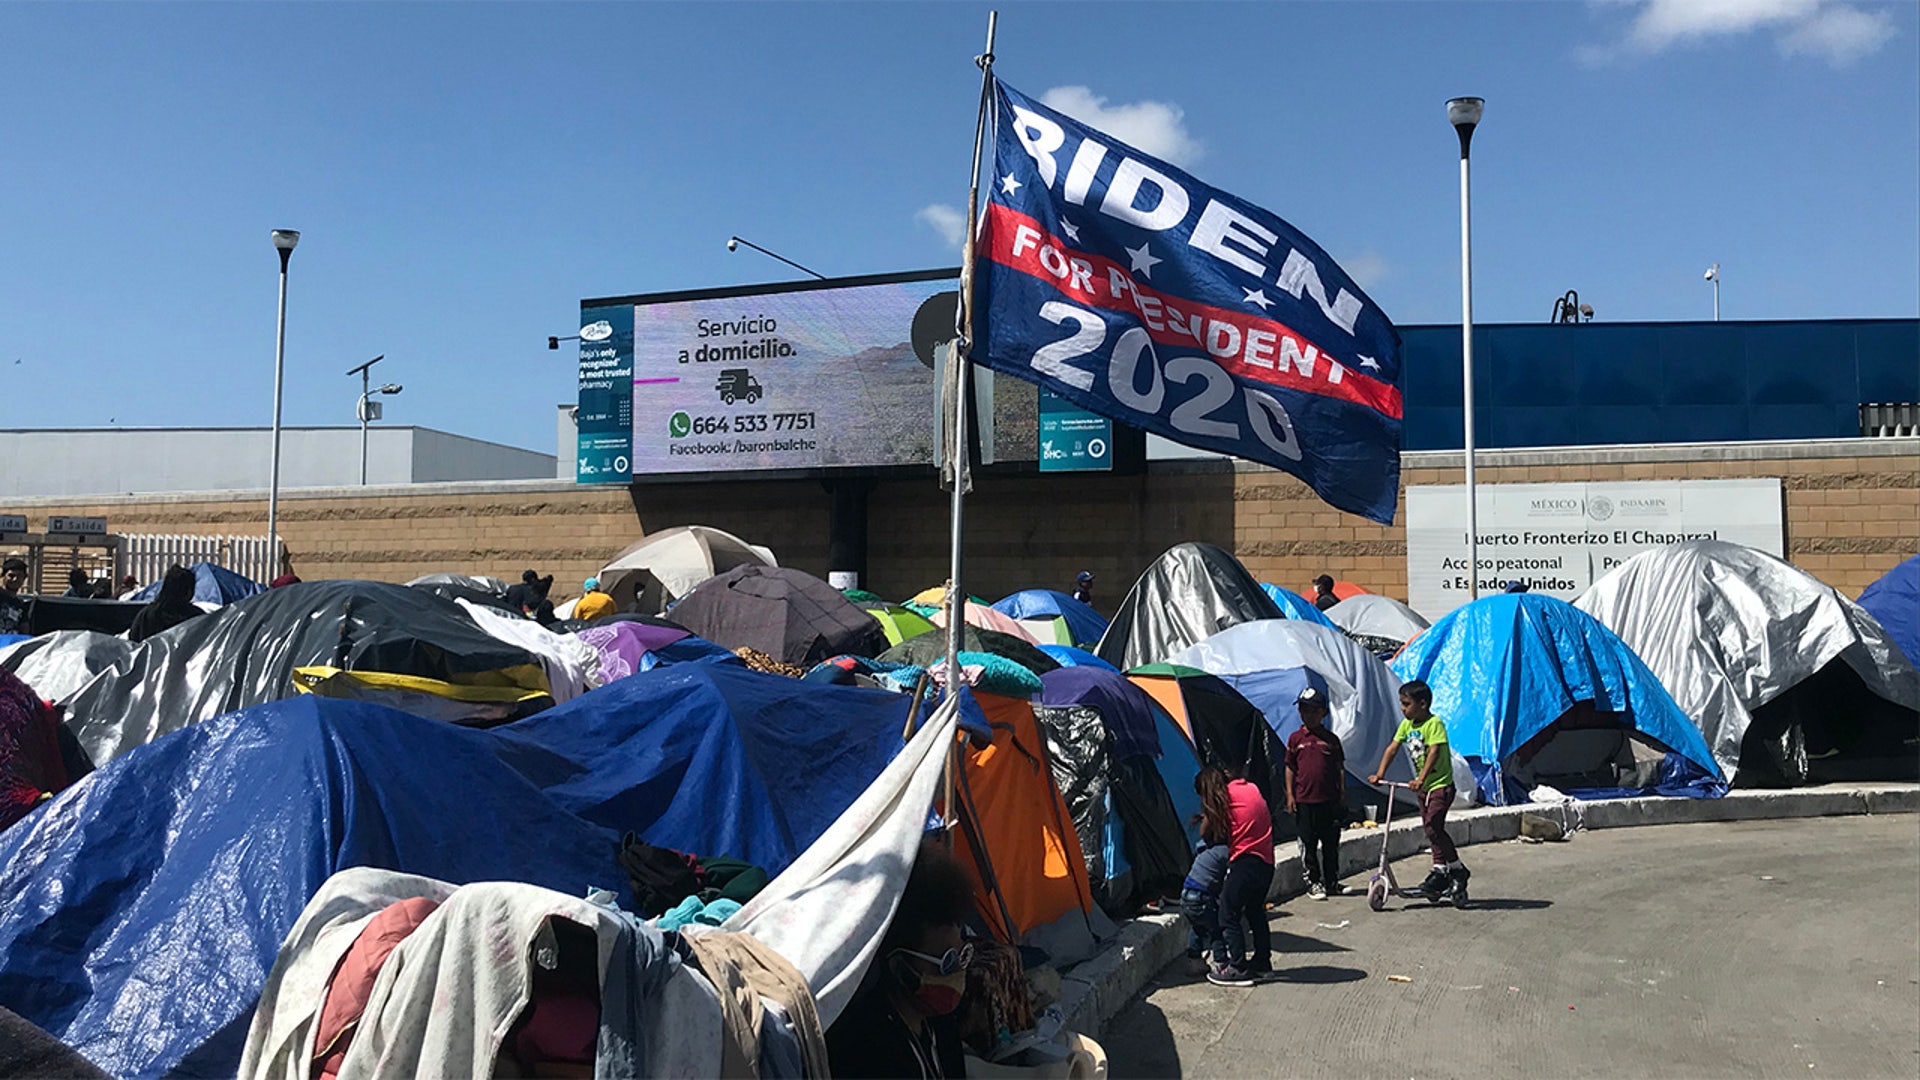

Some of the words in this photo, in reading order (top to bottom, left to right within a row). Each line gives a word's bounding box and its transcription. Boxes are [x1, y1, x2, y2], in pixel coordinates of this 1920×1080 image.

[1012, 223, 1096, 295] FOR
[697, 314, 777, 338] Servicio
[600, 348, 617, 358] only
[678, 350, 690, 364] a
[695, 338, 798, 363] domicilio.
[586, 370, 604, 378] most
[605, 367, 632, 377] trusted
[579, 381, 613, 391] pharmacy
[1030, 300, 1303, 461] 2020
[692, 416, 730, 435] 664
[733, 414, 768, 433] 533
[773, 412, 816, 431] 7751
[669, 441, 731, 456] Facebook:
[1530, 498, 1578, 510] MÉXICO
[68, 521, 102, 530] Salida
[1522, 530, 1610, 545] Fronterizo
[1613, 530, 1628, 545] El
[1442, 557, 1494, 570] Accso
[1496, 556, 1563, 572] peatonal
[1442, 580, 1450, 589] a
[1455, 576, 1509, 590] Esado
